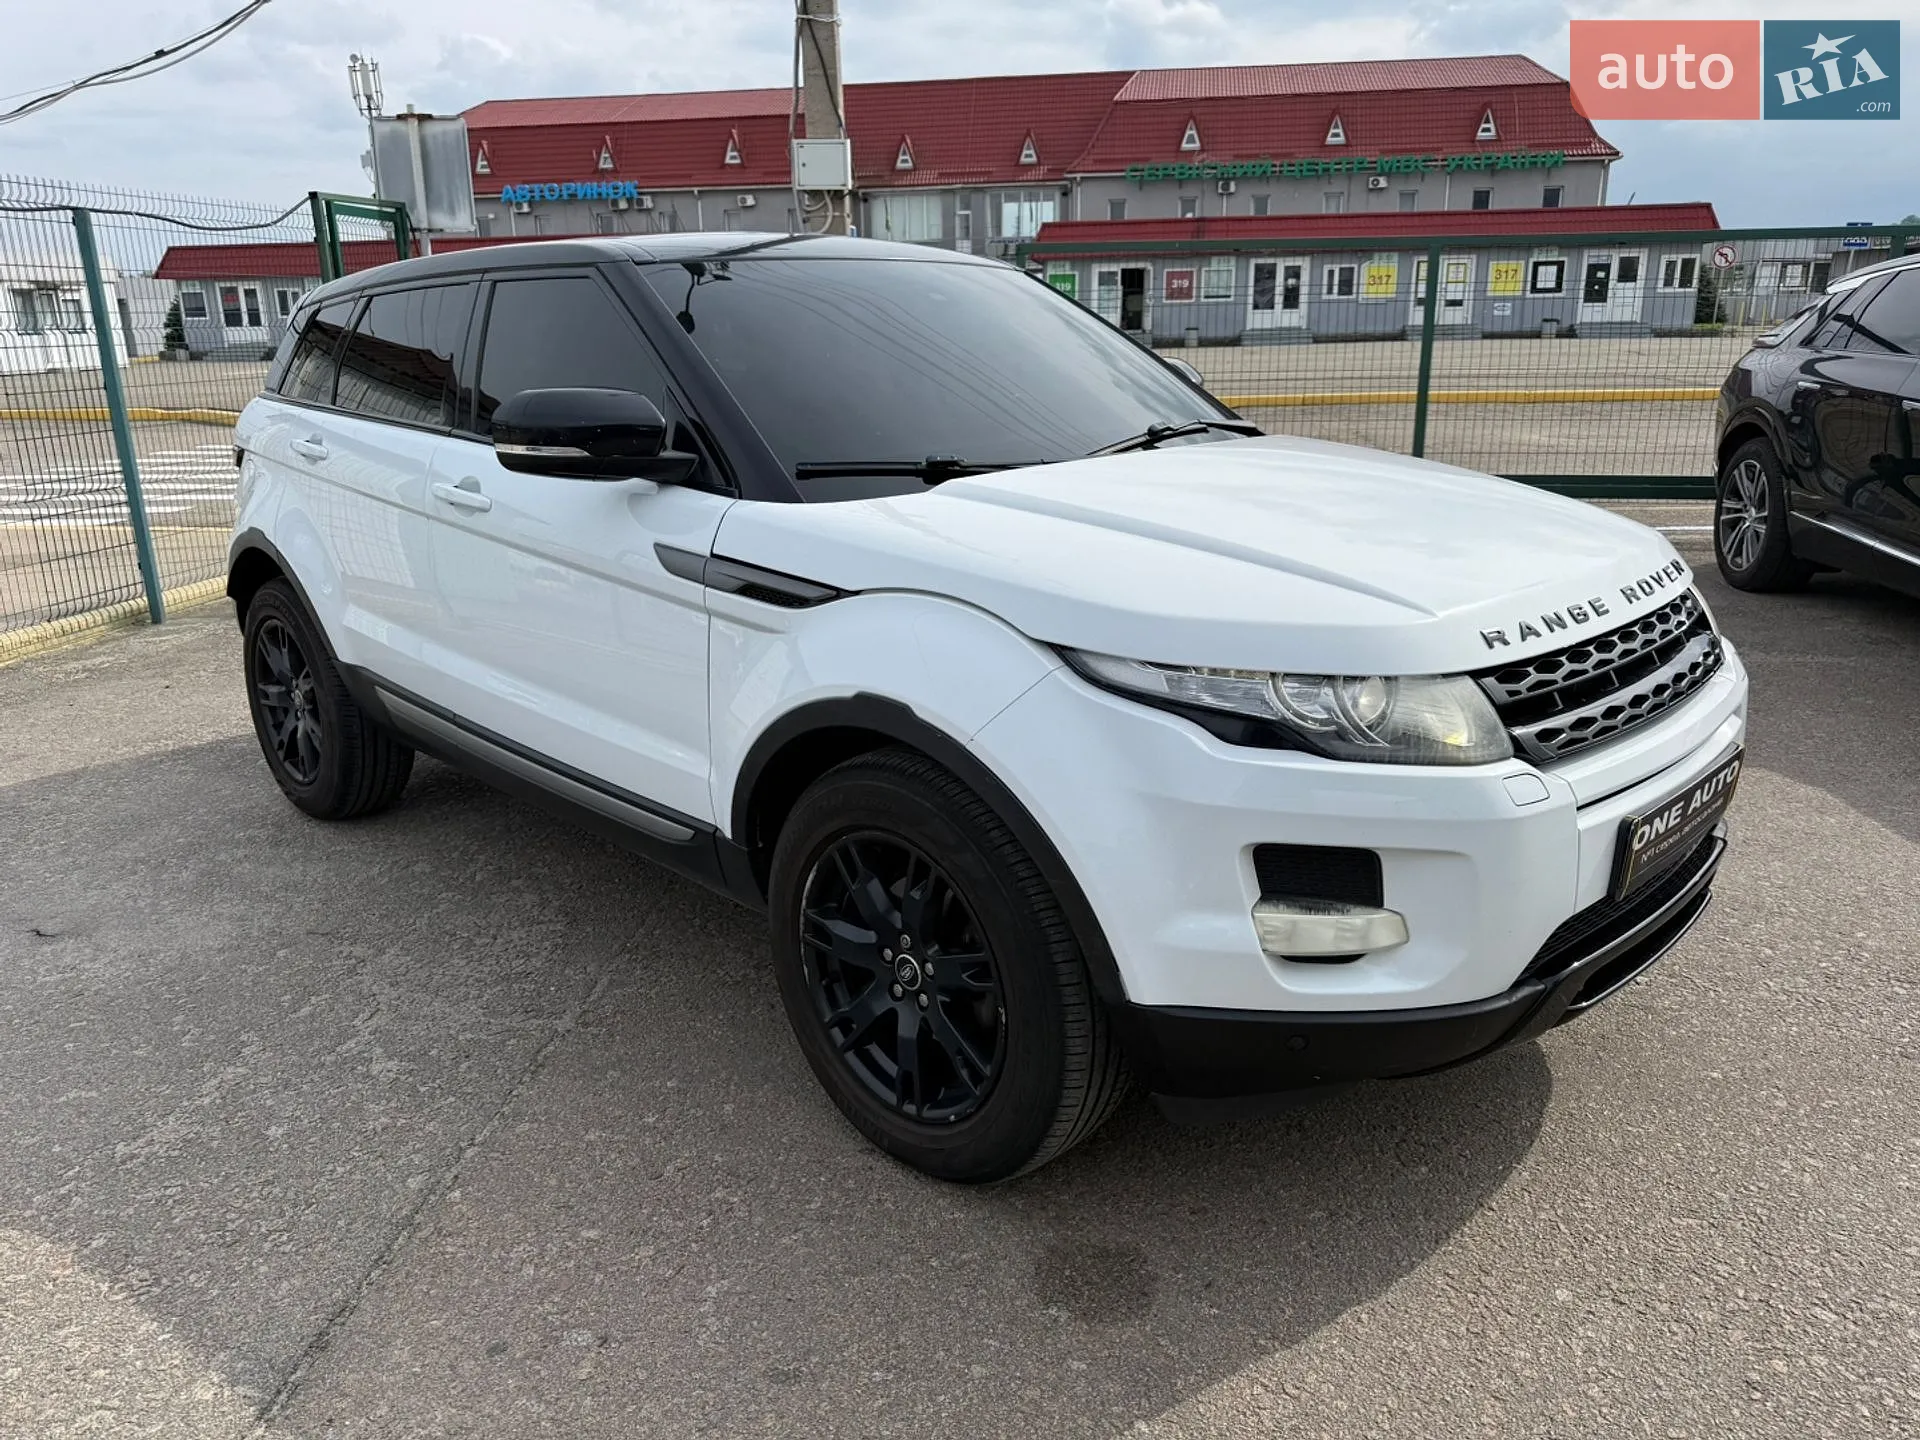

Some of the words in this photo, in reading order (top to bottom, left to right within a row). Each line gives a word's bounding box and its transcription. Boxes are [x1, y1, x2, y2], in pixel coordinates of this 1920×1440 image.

[1280, 157, 1368, 180] ЦЕНТР
[1375, 153, 1437, 174] МВС
[1444, 151, 1566, 173] УКРАЇНИ
[500, 179, 640, 204] АВТОРИНОК
[1170, 278, 1191, 289] 319
[1367, 274, 1392, 287] 317
[1494, 268, 1519, 281] 317
[1479, 596, 1610, 650] RANGE
[1619, 558, 1686, 605] ROVER
[1632, 800, 1685, 852] ONE
[1686, 760, 1740, 817] AUTO
